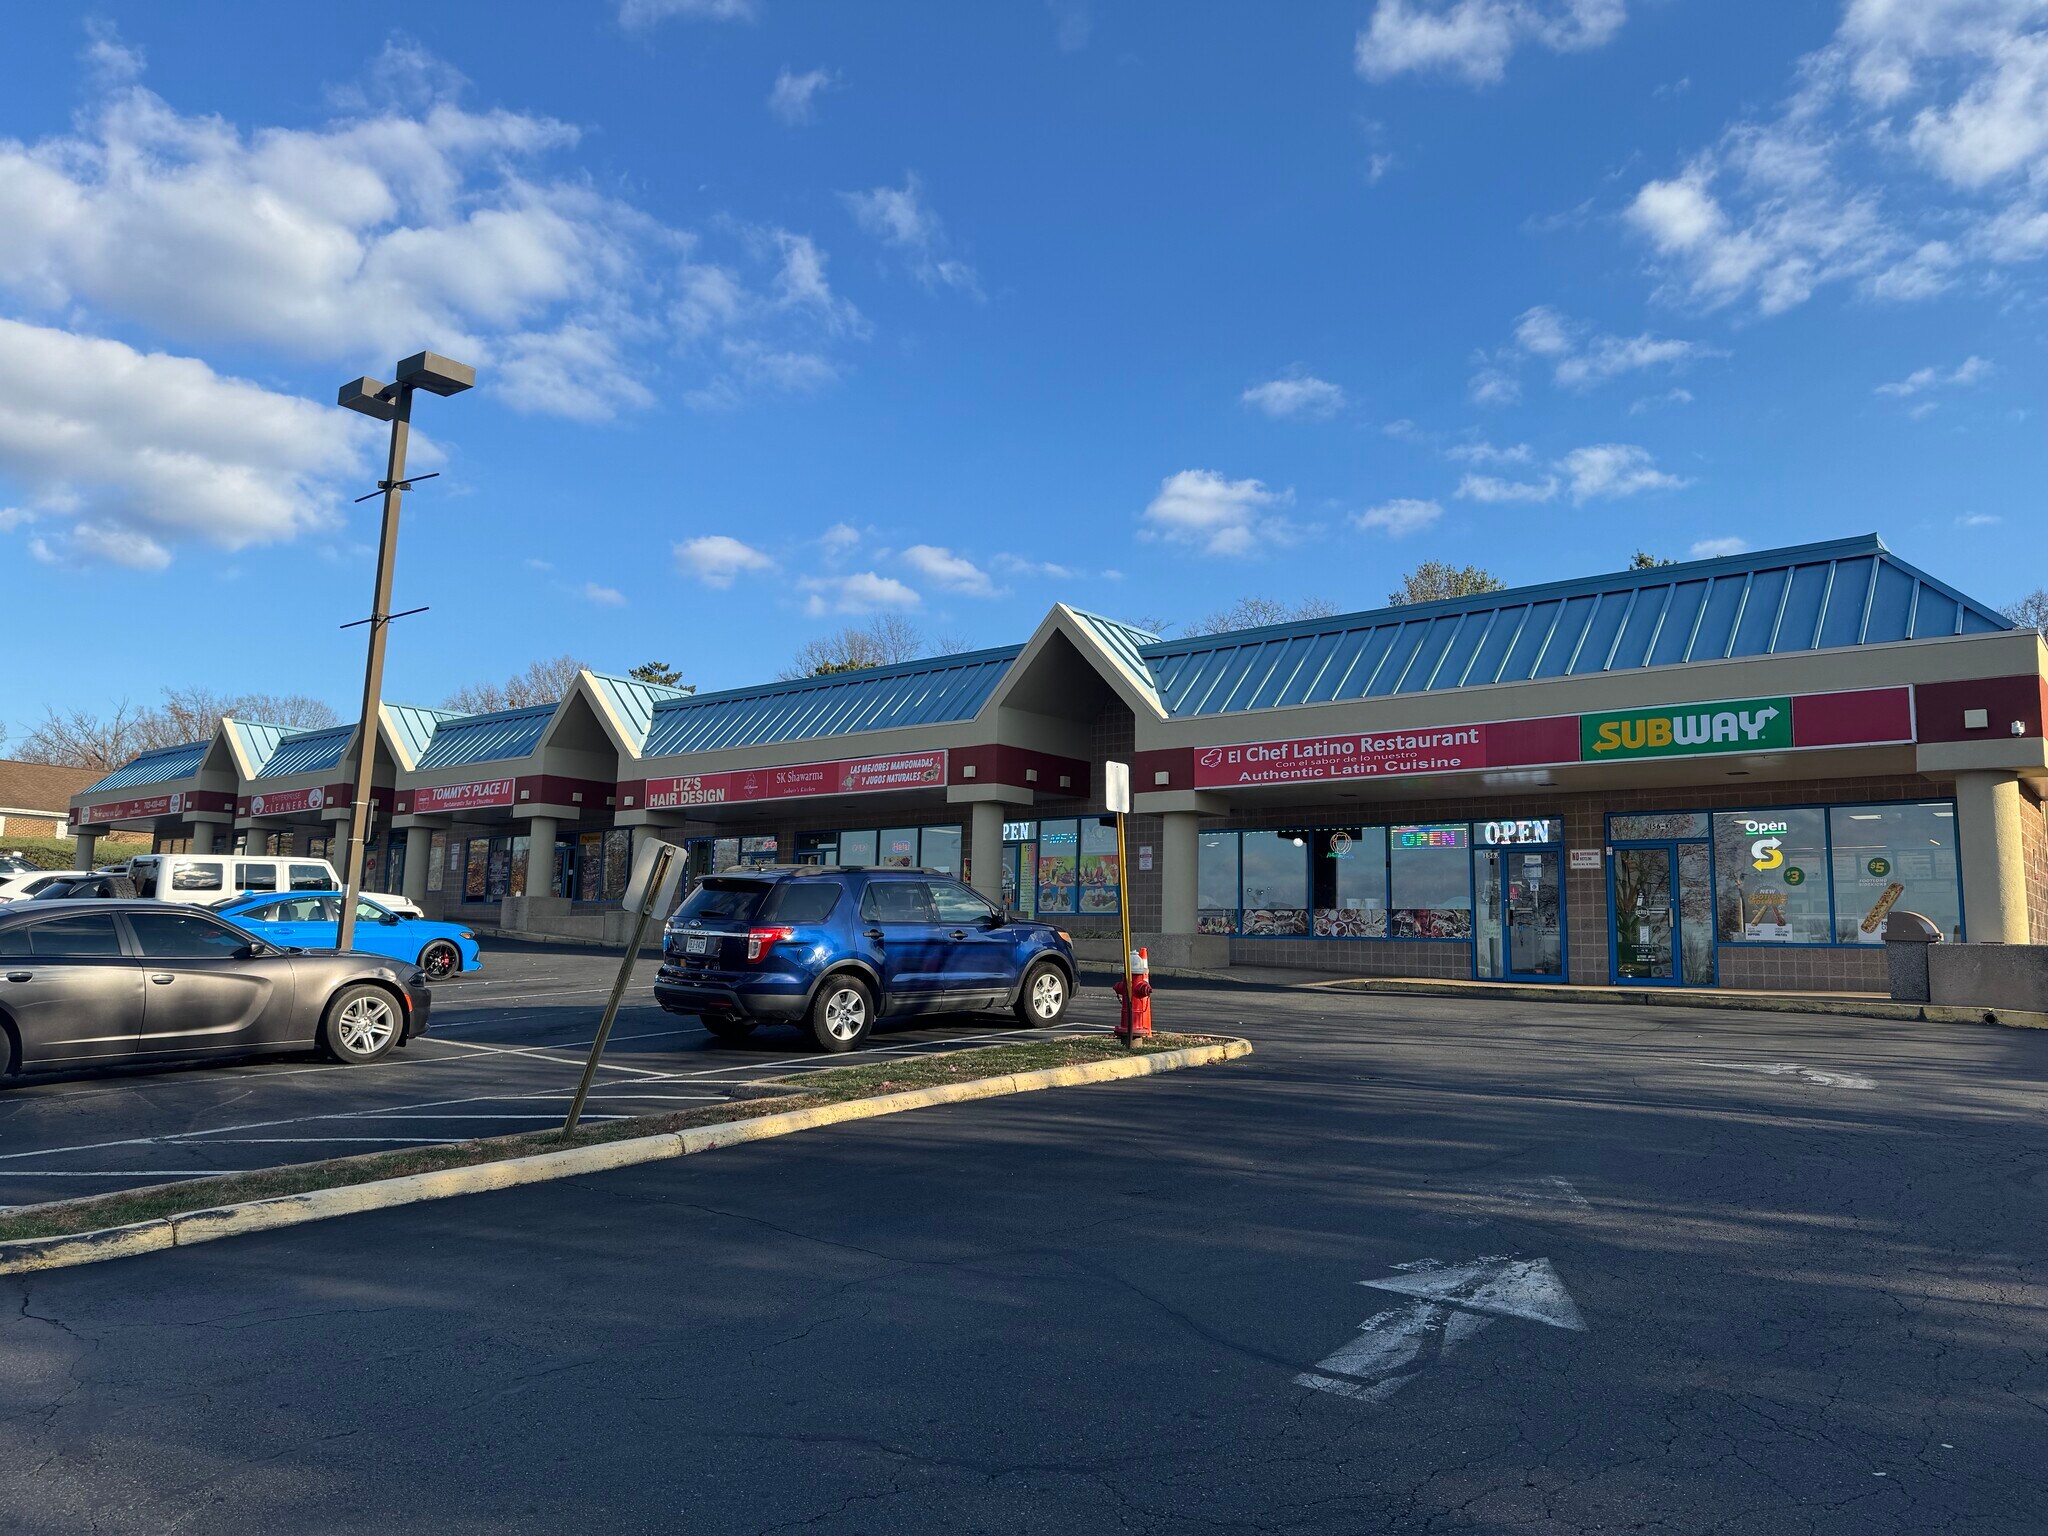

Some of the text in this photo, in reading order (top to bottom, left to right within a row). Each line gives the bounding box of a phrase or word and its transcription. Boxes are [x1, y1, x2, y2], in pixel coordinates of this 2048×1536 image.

[1592, 706, 1779, 753] SUBWAY
[1228, 728, 1479, 764] El Chef Latino Restaurant
[850, 758, 934, 774] LAS MEJORES MANGONADAS
[1275, 750, 1418, 768] Con el sabor de lo nuestro
[776, 769, 824, 784] SK Shawarma
[1238, 756, 1462, 782] Authentic Latin Cuisine
[673, 776, 702, 792] LIZ'S
[861, 772, 921, 785] Y JUGOS NATURALES
[432, 781, 510, 800] TOMMY'S PLACE II
[649, 788, 725, 807] HAIR DESIGN
[264, 799, 307, 813] CLEANERS
[1003, 822, 1029, 841] PEN
[1484, 819, 1550, 845] OPEN
[1745, 820, 1788, 834] Open
[1402, 831, 1456, 846] OPEN
[1572, 852, 1580, 861] NO
[1870, 861, 1885, 873] $5
[1786, 870, 1800, 882] $3
